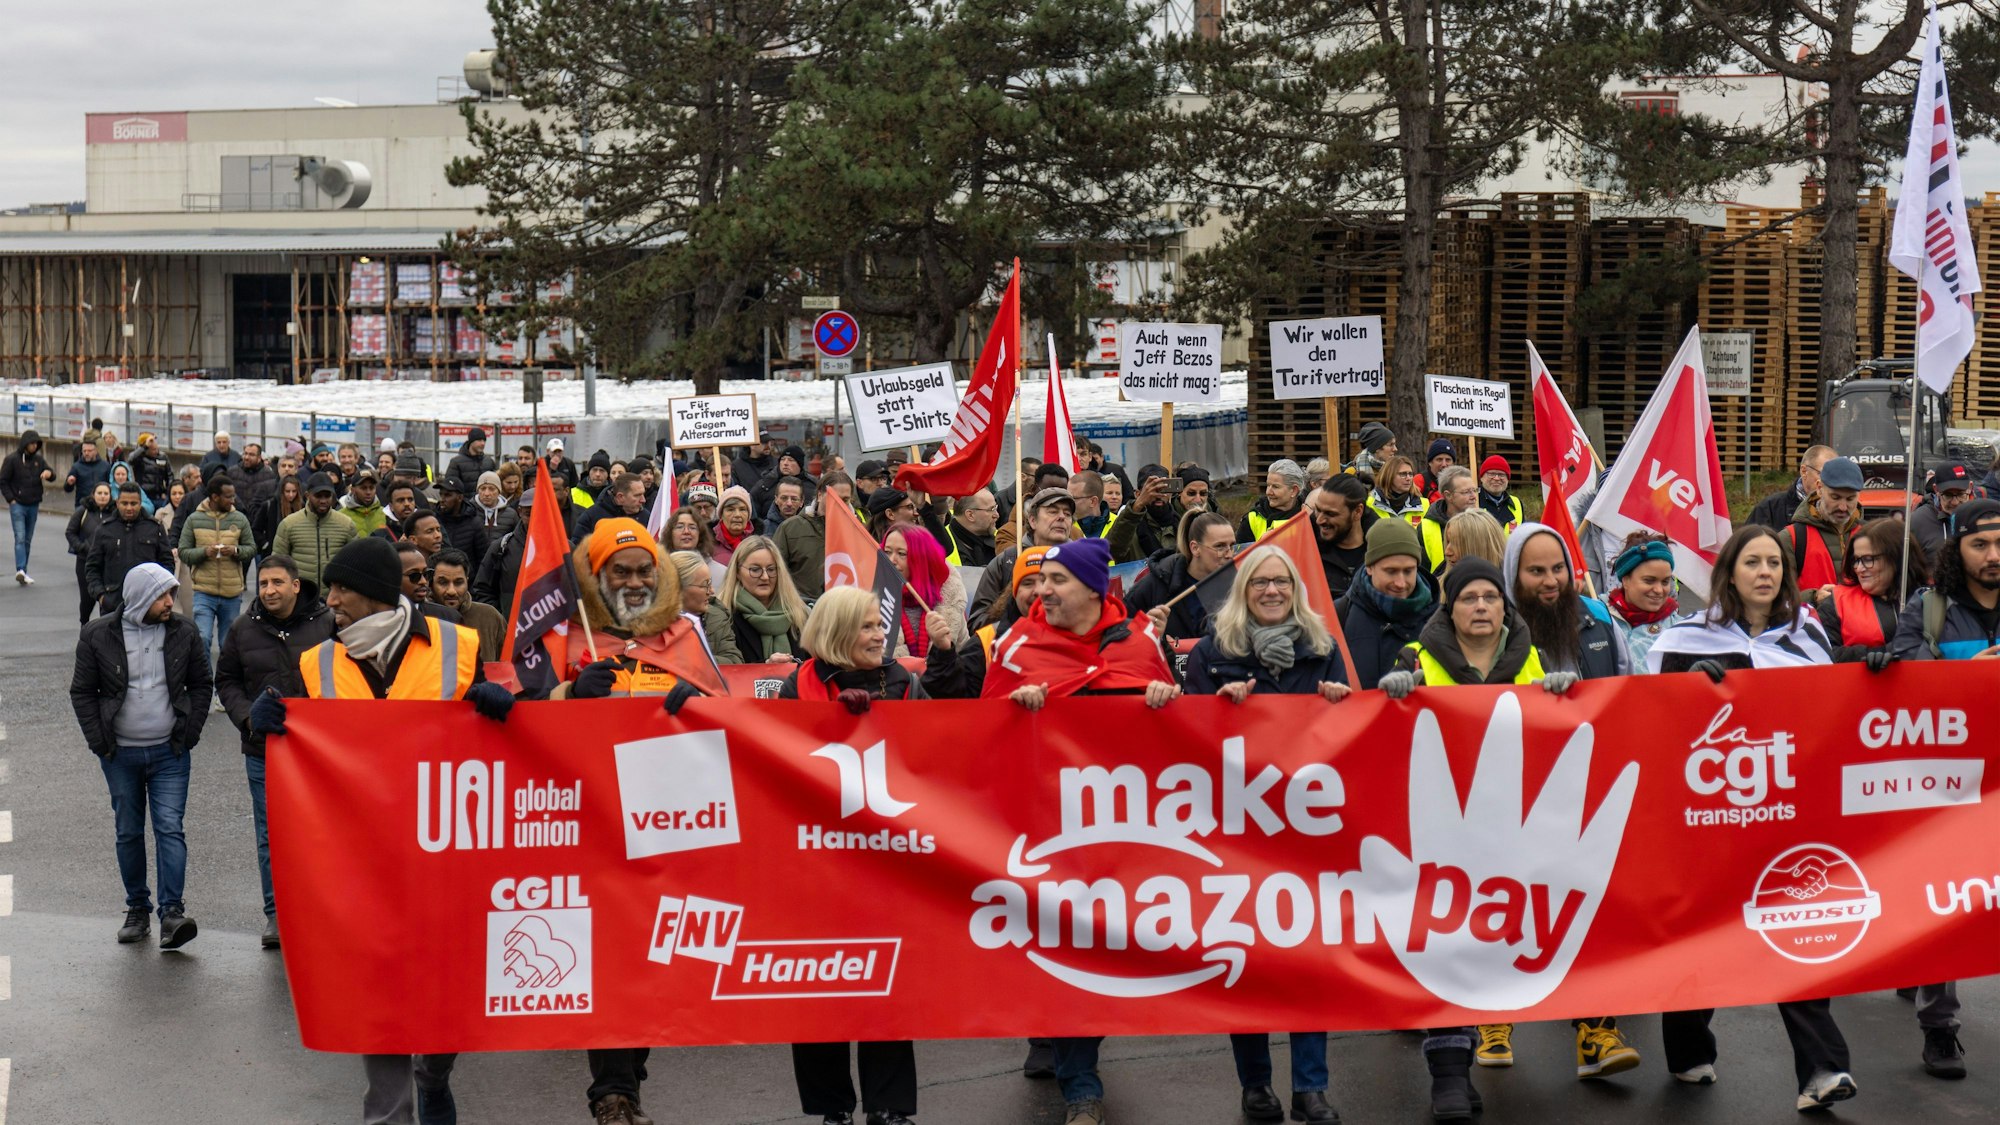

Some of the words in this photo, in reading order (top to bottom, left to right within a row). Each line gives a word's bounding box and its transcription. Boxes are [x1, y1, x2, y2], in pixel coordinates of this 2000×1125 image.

[1136, 329, 1168, 346] Auch
[1177, 336, 1207, 346] wenn
[1283, 325, 1314, 344] Wir
[1321, 322, 1368, 341] wollen
[1133, 349, 1166, 368] Jeff
[1173, 349, 1213, 366] Bezos
[1308, 345, 1336, 362] den
[860, 370, 944, 398] Urlaubsgeld
[1124, 372, 1145, 388] das
[1148, 372, 1179, 388] nicht
[1275, 362, 1384, 388] Tarifvertrag!
[1433, 380, 1471, 396] Flaschen
[1472, 386, 1484, 396] ins
[1484, 386, 1506, 402] Regal
[676, 408, 749, 420] Tarifvertrag
[690, 400, 710, 410] Für
[877, 395, 914, 414] statt
[1450, 398, 1474, 410] nicht
[1480, 400, 1494, 412] ins
[1840, 400, 1846, 408] 2
[694, 422, 726, 430] Gegen
[880, 410, 952, 434] T-Shirts
[1436, 410, 1506, 430] Management
[680, 426, 748, 440] Altersarmut
[1843, 455, 1904, 464] ARKUS
[1863, 476, 1894, 488] Linde
[1858, 708, 1969, 749] GMB
[1684, 731, 1796, 806] cgt
[1059, 735, 1346, 838] make
[1862, 776, 1962, 796] UNION
[514, 779, 582, 820] global
[630, 801, 727, 832] ver.di
[1685, 801, 1796, 828] transports
[514, 813, 580, 849] union
[797, 824, 936, 854] Handels
[490, 875, 589, 911] CGIL
[968, 867, 1377, 953] amazon
[1405, 861, 1588, 975] pay
[1760, 904, 1867, 925] RWDSU
[654, 910, 740, 948] FNV
[1794, 934, 1838, 945] UFCW
[742, 950, 878, 983] Handel
[489, 993, 590, 1013] FILCAMS
